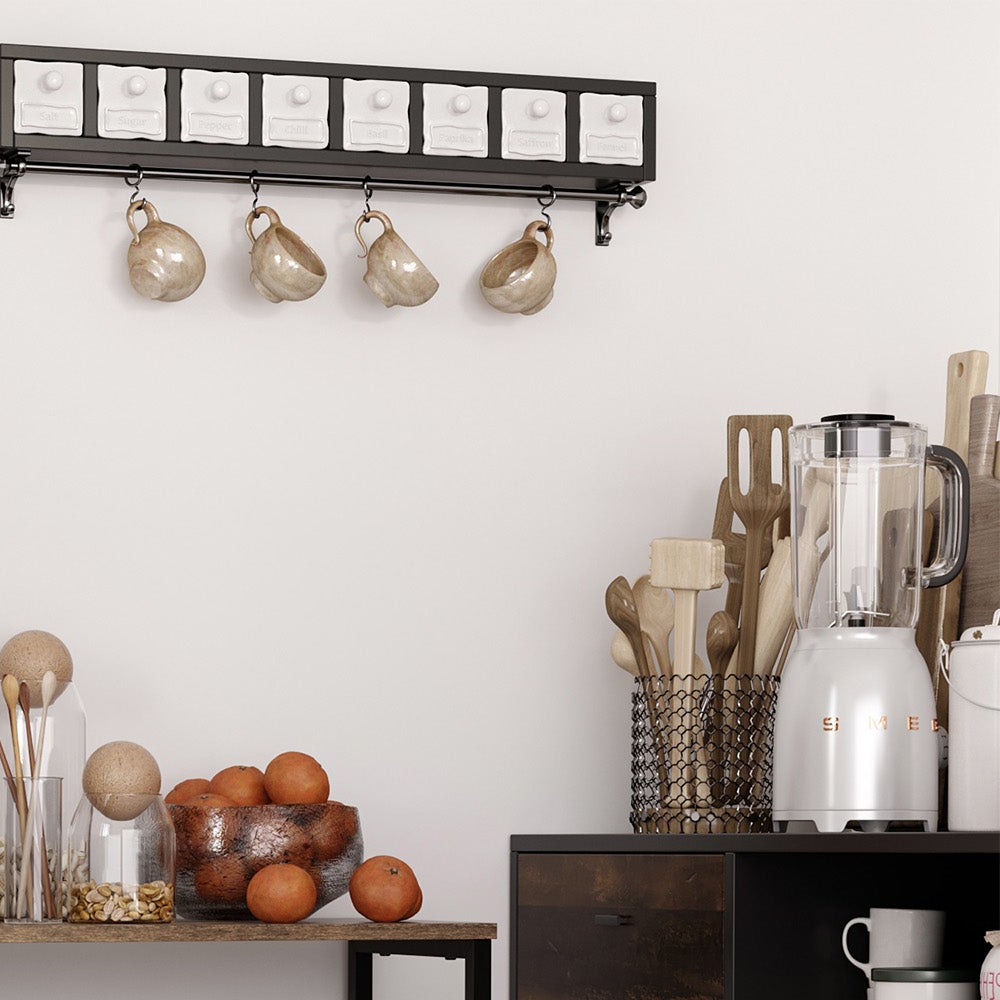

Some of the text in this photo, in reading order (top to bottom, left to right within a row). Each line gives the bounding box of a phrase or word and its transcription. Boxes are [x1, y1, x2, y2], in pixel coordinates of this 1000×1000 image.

[39, 110, 58, 121] Salt
[117, 115, 147, 128] Sugar
[198, 119, 233, 132] Pepper
[366, 128, 388, 139] Basil
[438, 132, 473, 145] Paprika
